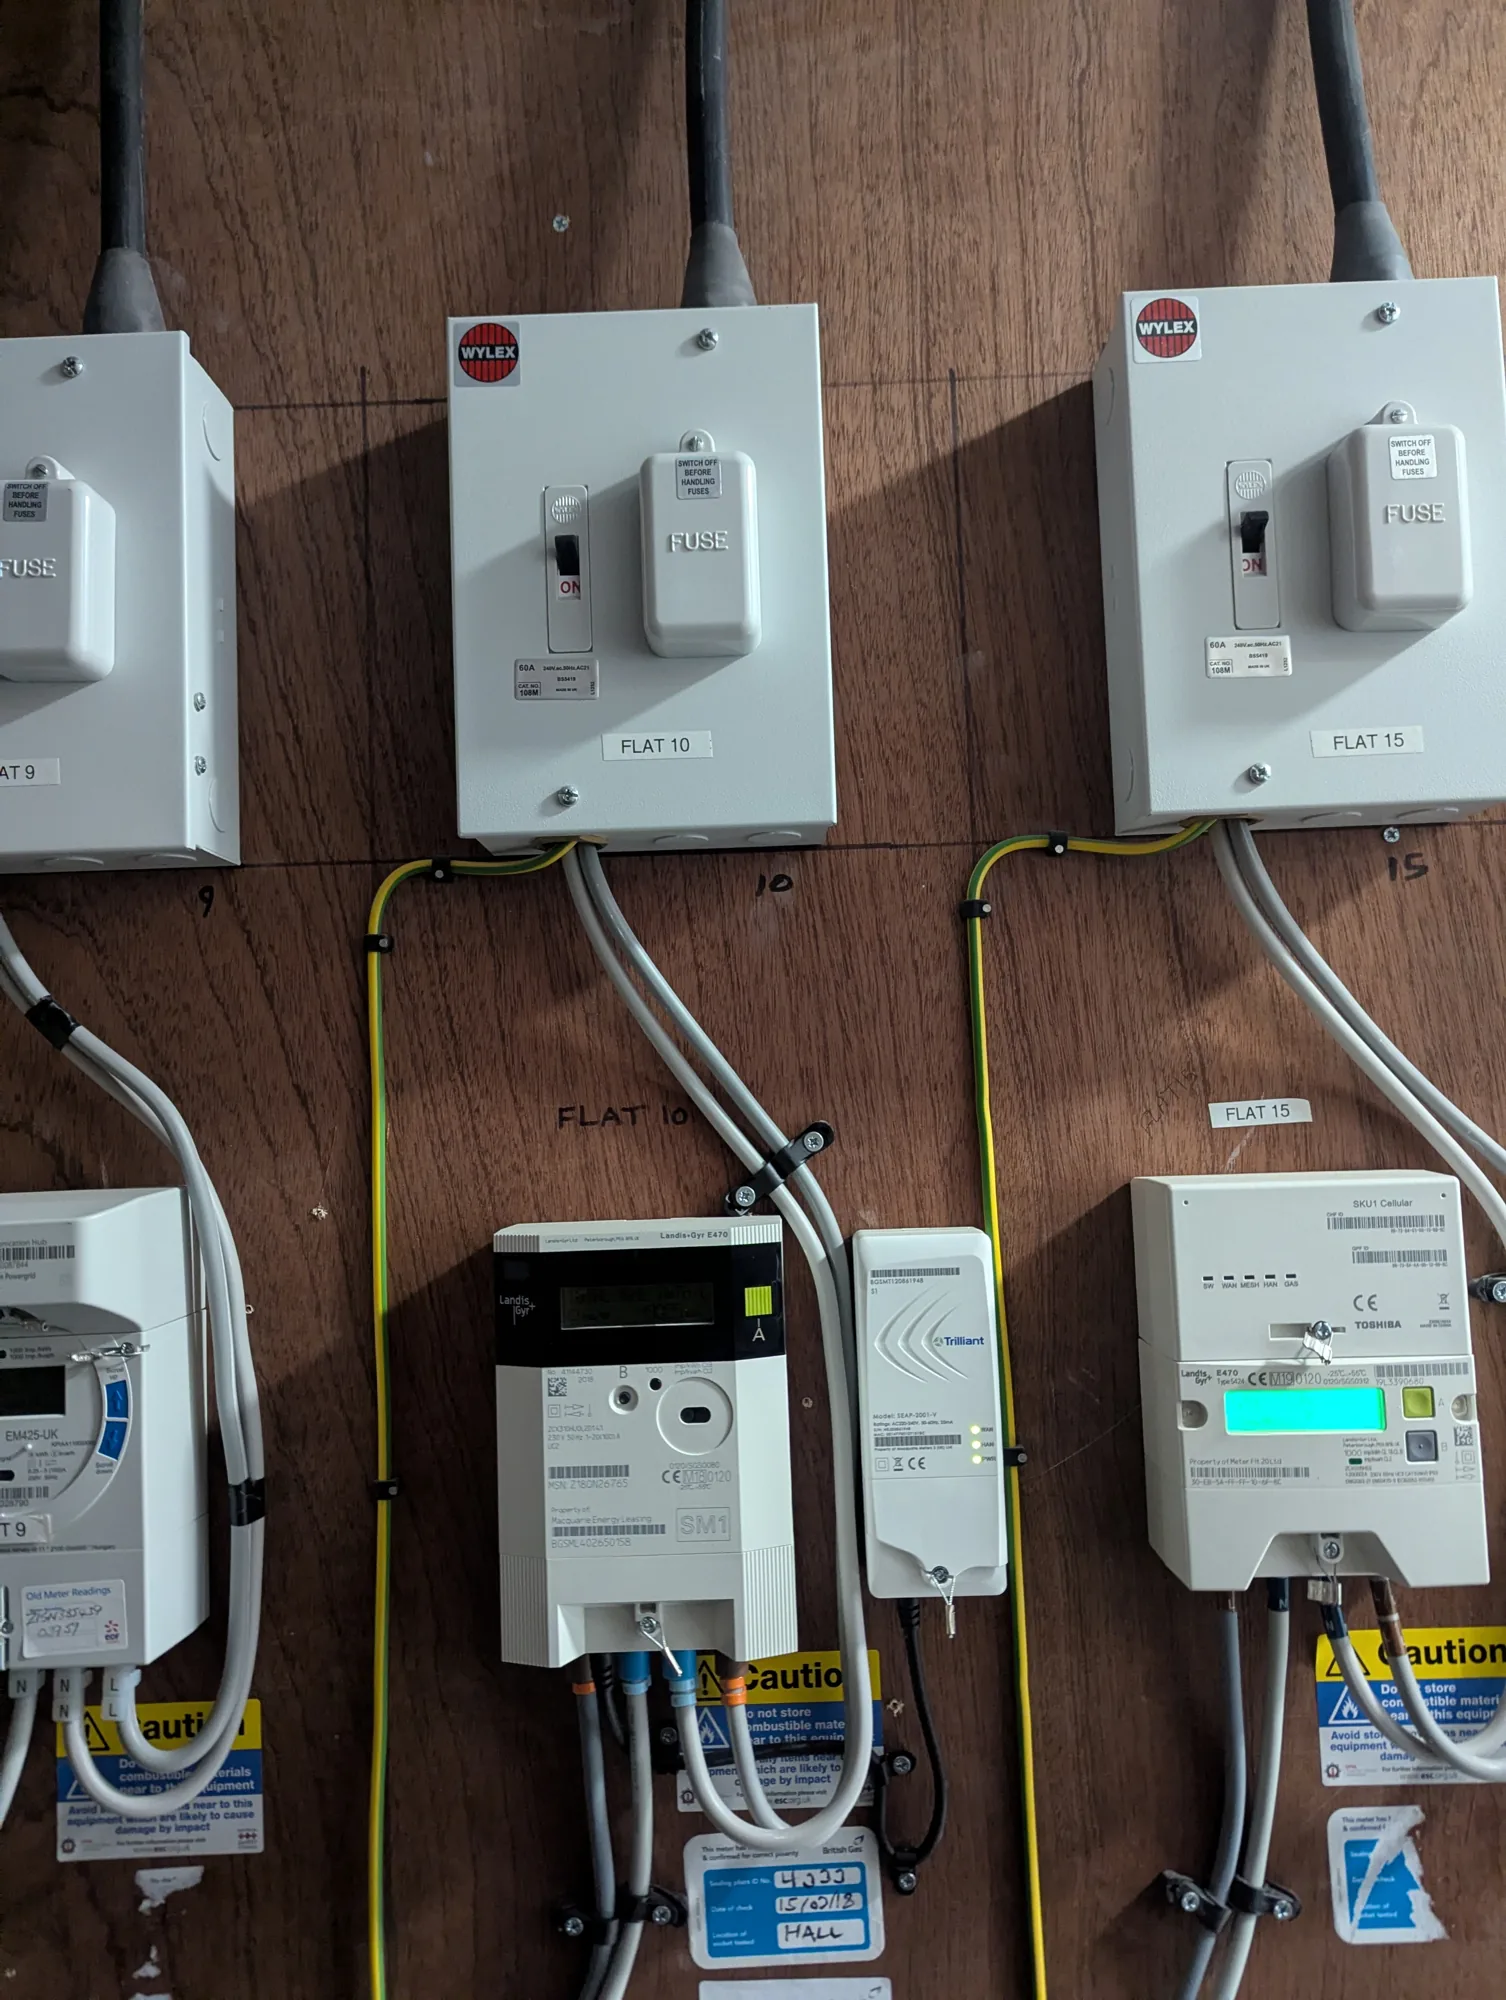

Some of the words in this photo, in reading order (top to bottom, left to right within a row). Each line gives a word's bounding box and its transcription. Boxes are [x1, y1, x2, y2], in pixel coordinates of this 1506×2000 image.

[1138, 320, 1195, 336] WYLEX
[461, 346, 516, 359] WYLEX
[1390, 440, 1417, 448] SWITCH
[1398, 449, 1425, 457] BEFORE
[1395, 458, 1430, 466] HANDLING
[1402, 468, 1424, 476] FUSES
[14, 510, 36, 518] FUSES
[1384, 502, 1446, 524] FUSE
[670, 530, 729, 553] FUSE
[0, 557, 57, 578] FUSE
[560, 581, 581, 594] ON
[621, 738, 665, 754] FLAT
[671, 737, 690, 752] 10
[1333, 733, 1378, 750] FLAT
[1384, 732, 1405, 748] 15
[25, 764, 35, 780] 9
[1388, 852, 1429, 881] 15
[755, 873, 794, 897] 10
[198, 885, 214, 918] 9
[558, 1104, 646, 1130] FLAT
[662, 1104, 688, 1125] 10
[1225, 1105, 1265, 1121] FLAT
[1272, 1103, 1290, 1118] 15
[1353, 1199, 1377, 1208] SKU1
[1380, 1199, 1412, 1207] Cellular
[500, 1294, 530, 1305] Landis
[1355, 1320, 1402, 1330] TOSHIBA
[752, 1327, 765, 1341] A
[944, 1336, 984, 1346] Trilliant
[619, 1366, 628, 1379] B
[1181, 1369, 1207, 1377] Landis
[1216, 1369, 1238, 1377] E470
[1295, 1372, 1321, 1385] 0120
[5, 1428, 58, 1442] EM425-UK
[1189, 1458, 1220, 1466] Property
[708, 1470, 732, 1483] 0120
[551, 1506, 580, 1514] Property
[552, 1516, 591, 1525] Macquarie
[592, 1515, 620, 1525] Energy
[622, 1515, 652, 1524] Leasing
[680, 1514, 727, 1535] SM1
[15, 1521, 26, 1537] 9
[26, 1591, 42, 1601] Old
[44, 1590, 69, 1599] Meter
[72, 1587, 111, 1597] Readings
[1279, 1598, 1289, 1609] N
[744, 1661, 844, 1691] Cautio
[16, 1679, 27, 1693] N
[60, 1678, 70, 1692] N
[110, 1677, 119, 1692] L
[1424, 1683, 1456, 1694] store
[60, 1704, 69, 1718] N
[108, 1703, 118, 1717] L
[757, 1708, 777, 1718] not
[780, 1707, 812, 1718] store
[769, 1734, 781, 1744] to
[1331, 1730, 1360, 1740] Avoid
[1330, 1741, 1387, 1753] equipment
[779, 1765, 796, 1773] are
[800, 1763, 827, 1775] likely
[830, 1764, 841, 1772] to
[779, 1776, 792, 1786] by
[795, 1774, 831, 1785] impact
[69, 1805, 97, 1816] Avoid
[193, 1800, 218, 1810] near
[220, 1800, 230, 1809] to
[233, 1799, 253, 1808] this
[159, 1813, 177, 1822] are
[179, 1810, 208, 1823] likely
[210, 1811, 220, 1820] to
[223, 1810, 255, 1820] cause
[115, 1825, 156, 1836] damage
[159, 1824, 171, 1834] by
[174, 1822, 211, 1833] impact
[823, 1845, 847, 1855] British
[709, 1853, 740, 1861] confirmed
[784, 1923, 843, 1942] HALL
